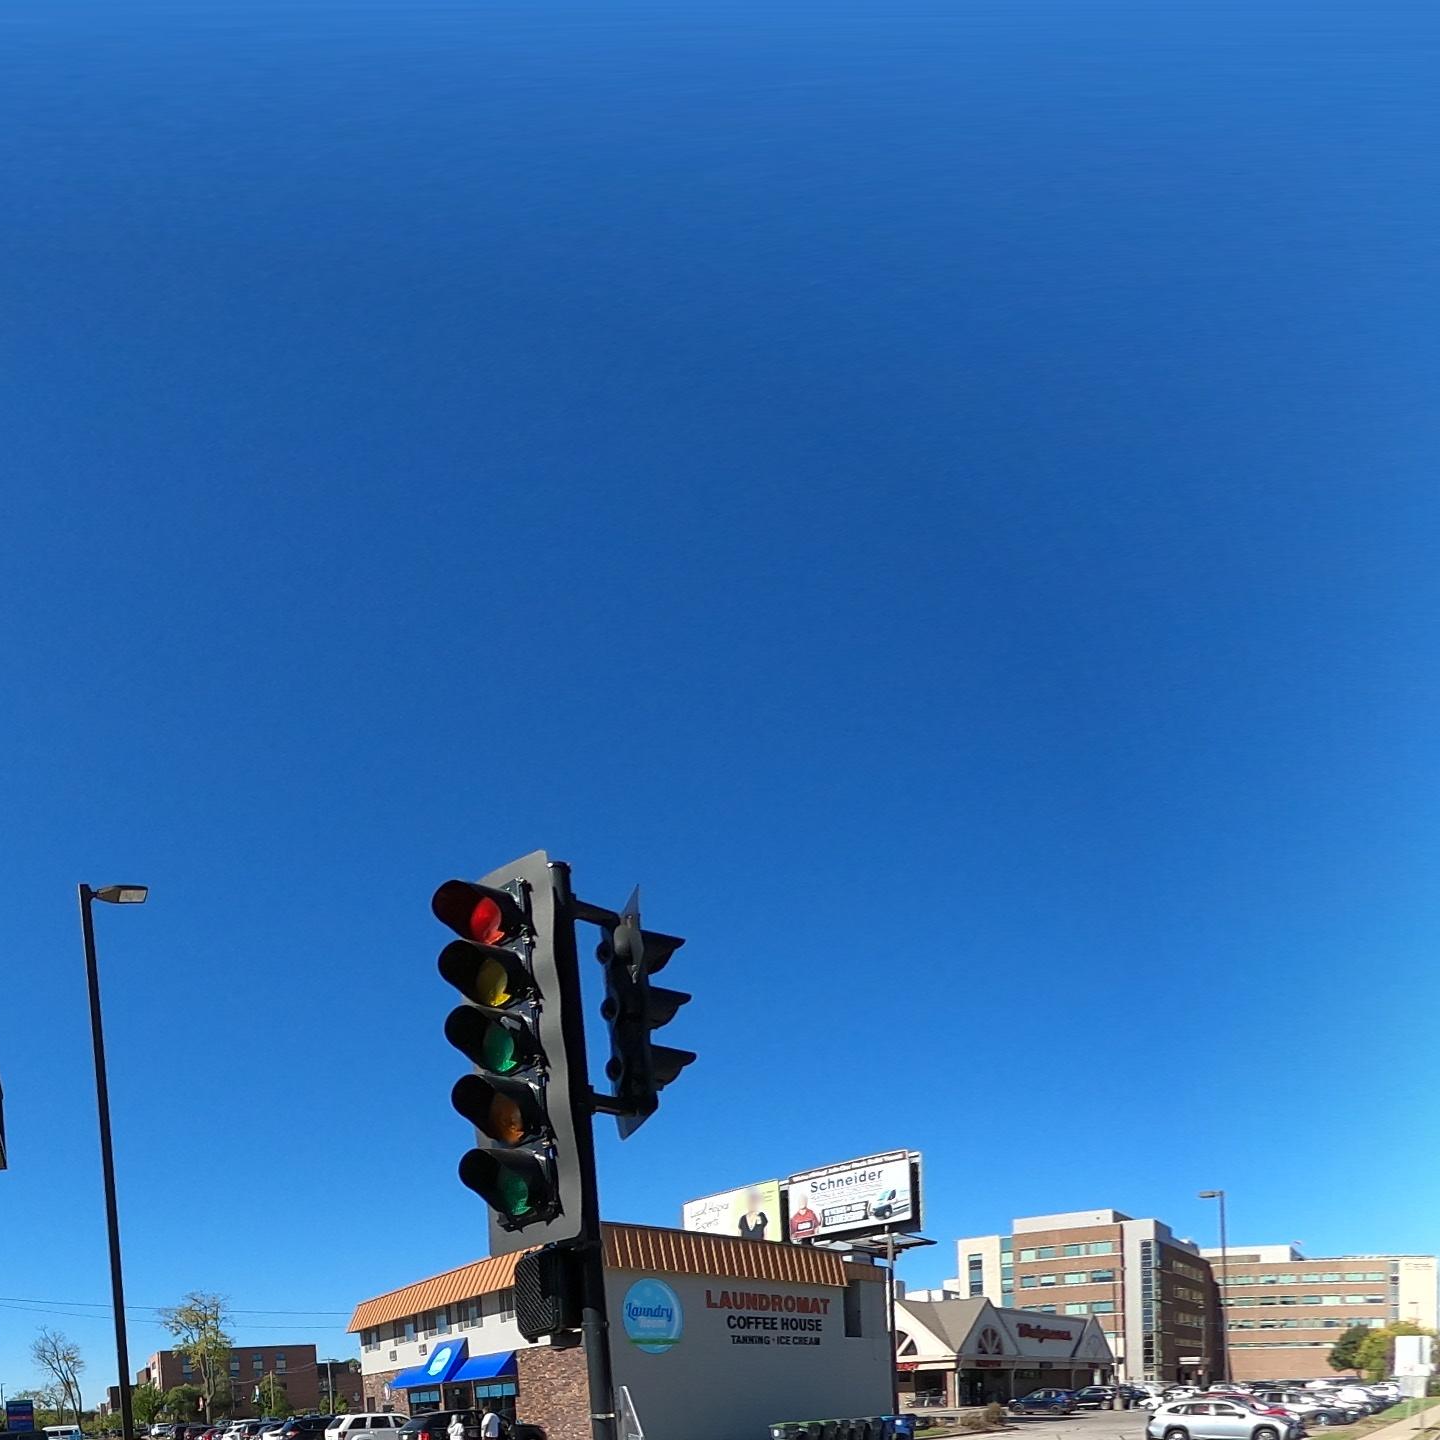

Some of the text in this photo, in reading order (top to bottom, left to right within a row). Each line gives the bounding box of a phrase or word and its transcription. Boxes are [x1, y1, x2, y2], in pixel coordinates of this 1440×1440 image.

[810, 1169, 884, 1193] Schneider
[626, 1302, 673, 1322] Laundry
[705, 1289, 830, 1315] LAUNDROMAT
[727, 1314, 823, 1332] COFFEE HOUSE
[730, 1334, 821, 1346] TANNING ICE CREAM
